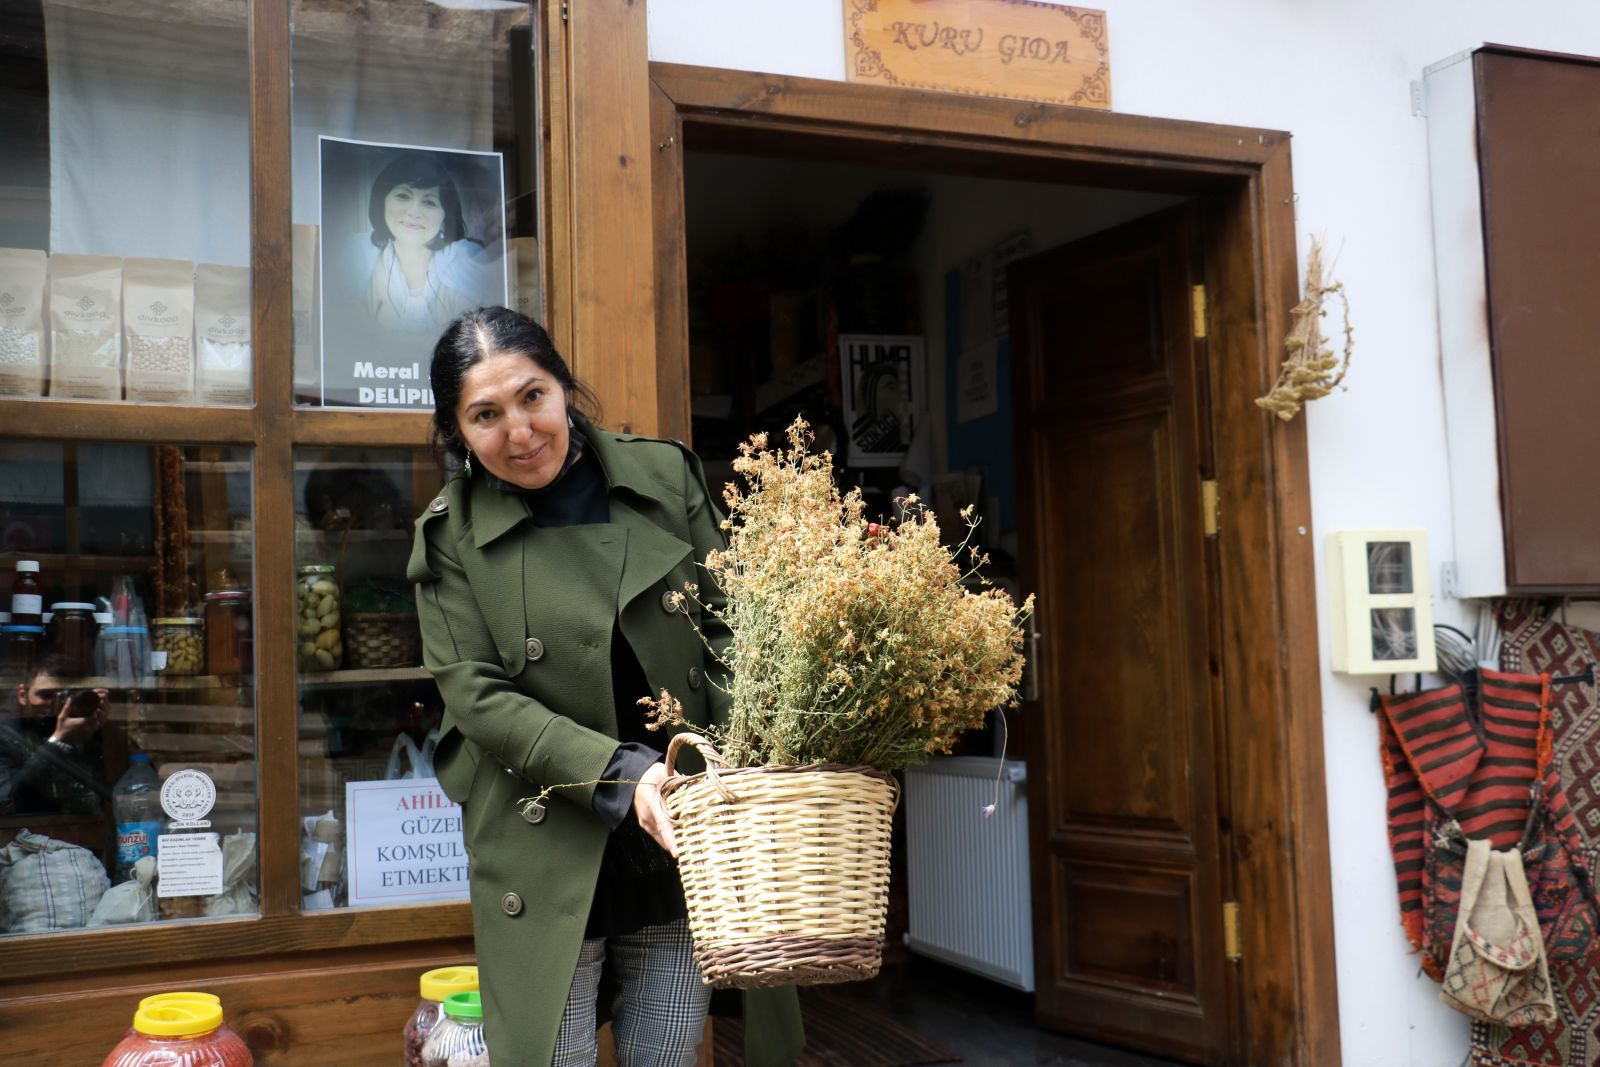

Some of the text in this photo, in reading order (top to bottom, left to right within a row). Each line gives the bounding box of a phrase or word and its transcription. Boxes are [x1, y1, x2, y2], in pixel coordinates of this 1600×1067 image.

[891, 21, 1071, 65] KURU GIDA
[353, 361, 420, 380] Meral
[396, 791, 461, 811] AHİL
